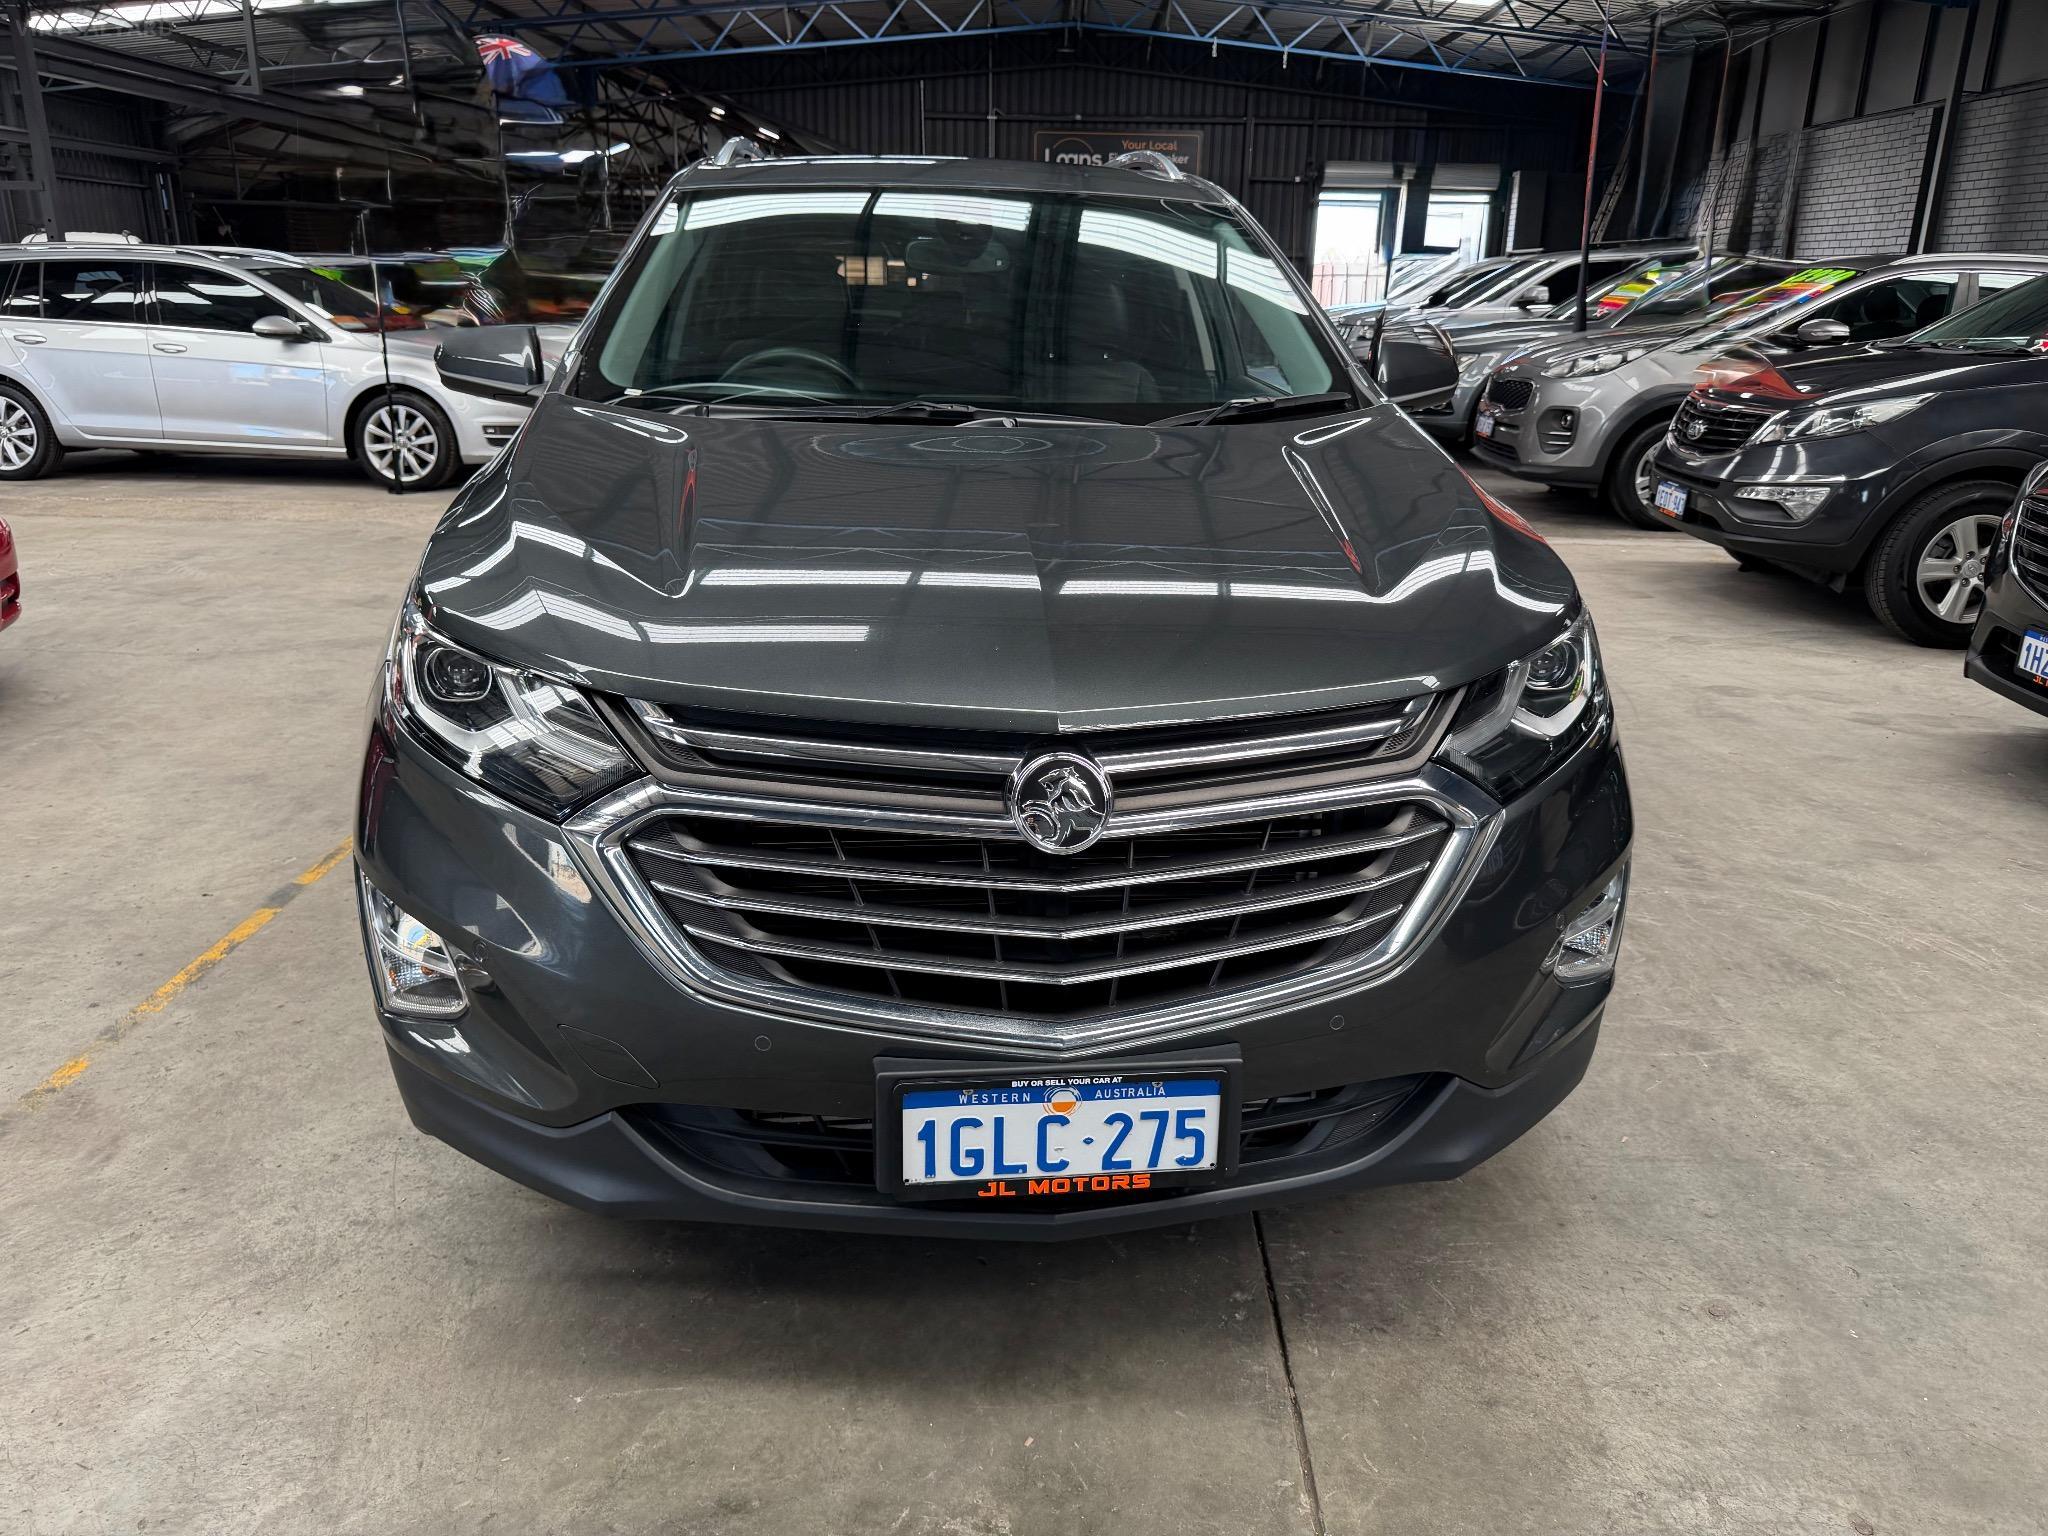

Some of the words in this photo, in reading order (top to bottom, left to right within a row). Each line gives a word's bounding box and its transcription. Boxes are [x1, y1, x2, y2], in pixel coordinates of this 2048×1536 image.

[1121, 139, 1147, 150] Your
[1149, 140, 1178, 151] Local
[1011, 1080, 1028, 1088] BUY
[1045, 1078, 1066, 1086] SELL
[1067, 1078, 1091, 1086] YOUR
[1093, 1077, 1111, 1085] CAR
[1112, 1076, 1123, 1084] AT
[959, 1092, 1031, 1104] WESTERN
[1095, 1085, 1166, 1100] AUSTRALIA
[978, 1181, 1016, 1197] JL
[1028, 1173, 1151, 1195] MOTORS
